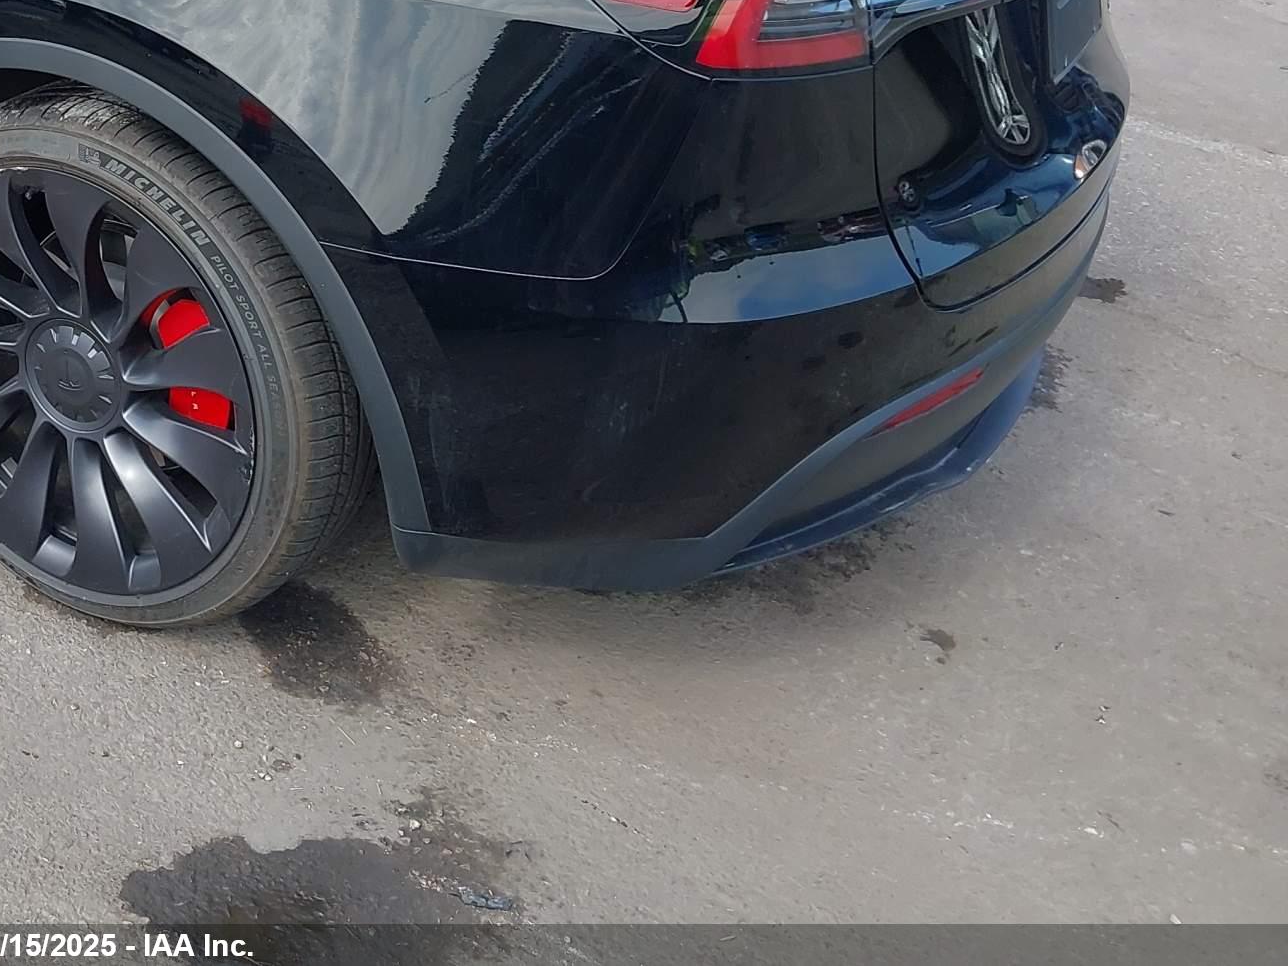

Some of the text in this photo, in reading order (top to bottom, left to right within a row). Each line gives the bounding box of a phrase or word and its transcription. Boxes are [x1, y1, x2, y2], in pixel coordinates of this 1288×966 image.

[104, 157, 212, 247] MICHELIN
[210, 255, 240, 291] PILOT
[235, 294, 263, 339] SPORT
[256, 343, 274, 370] ALL
